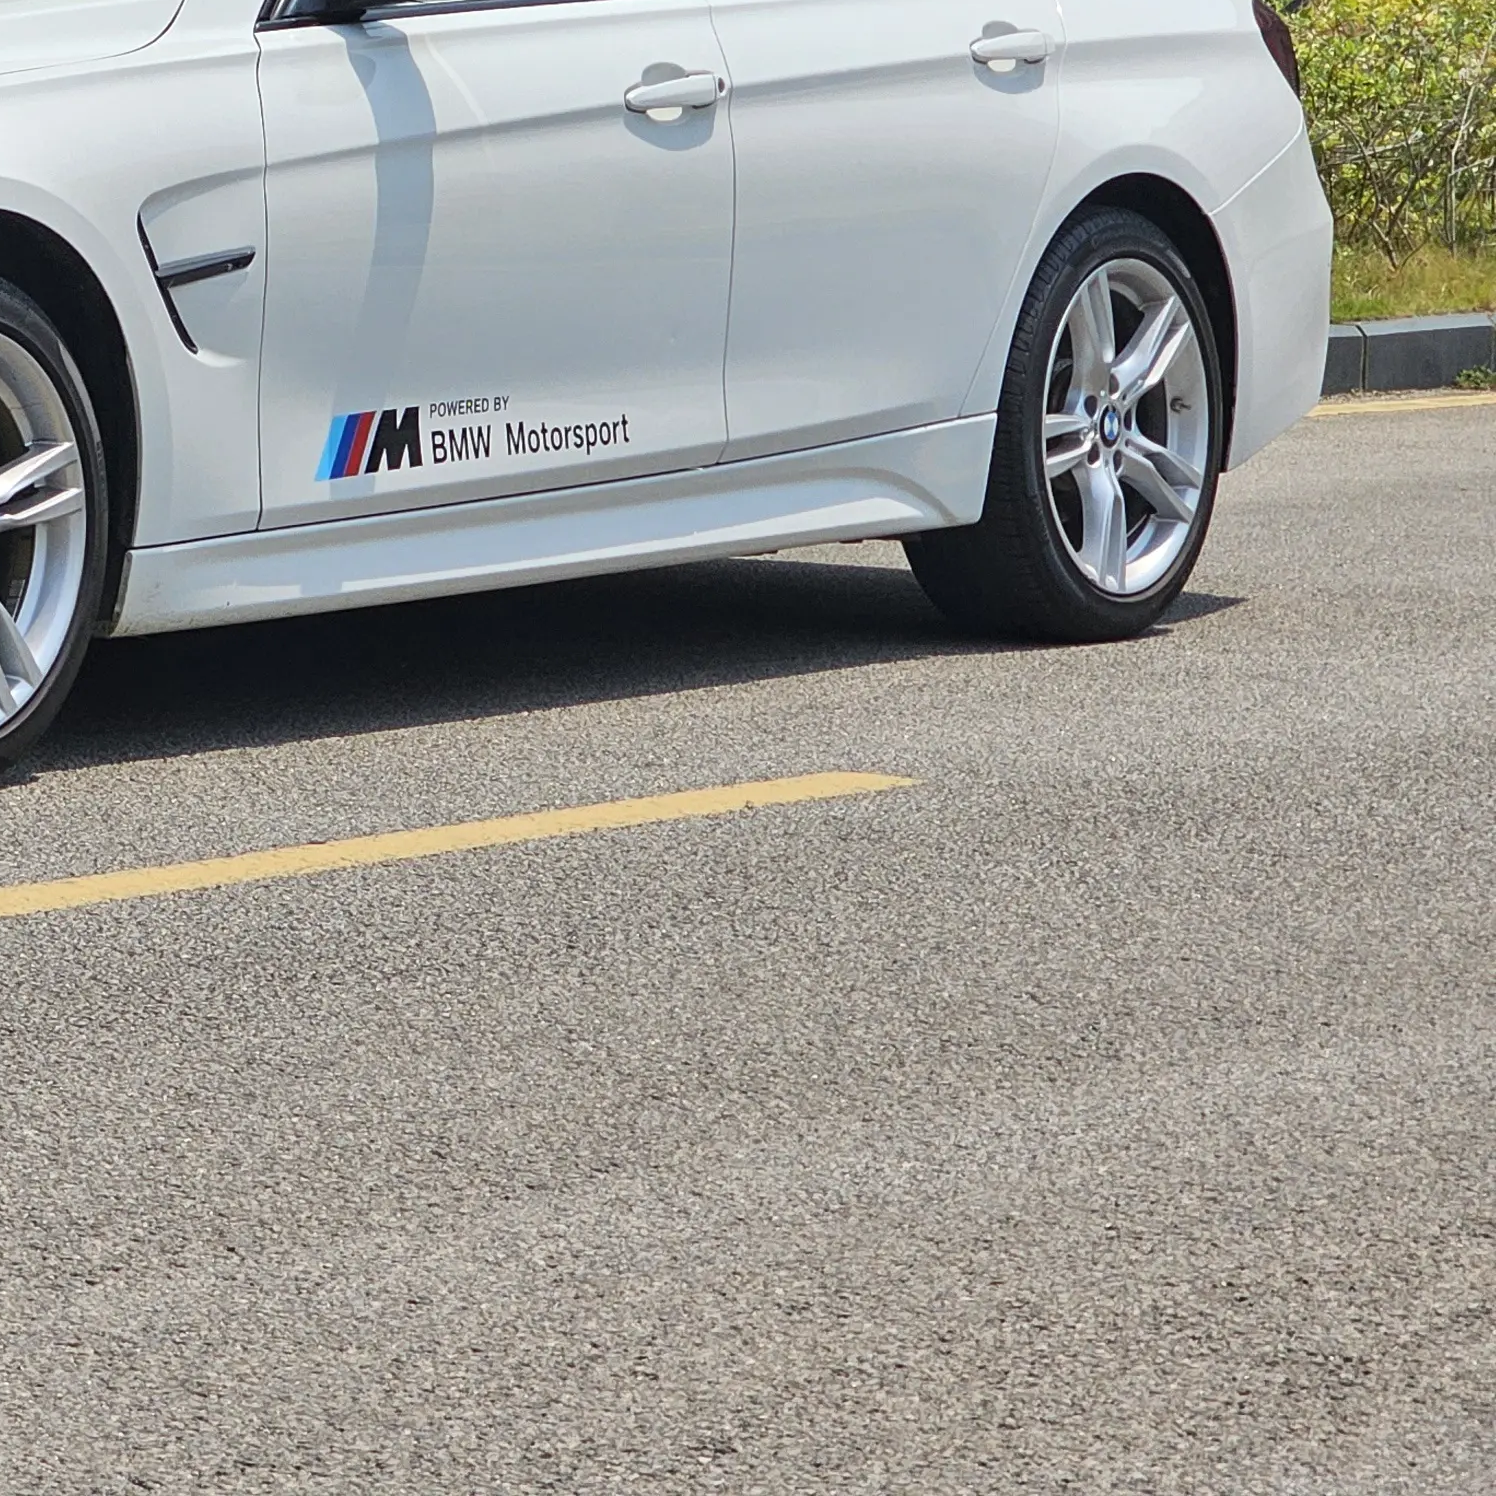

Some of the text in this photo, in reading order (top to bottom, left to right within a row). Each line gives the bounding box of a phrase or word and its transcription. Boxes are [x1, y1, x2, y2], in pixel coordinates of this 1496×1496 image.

[429, 395, 510, 419] POWERED BY
[364, 406, 423, 475] M
[431, 413, 631, 465] BMW Motorsport
